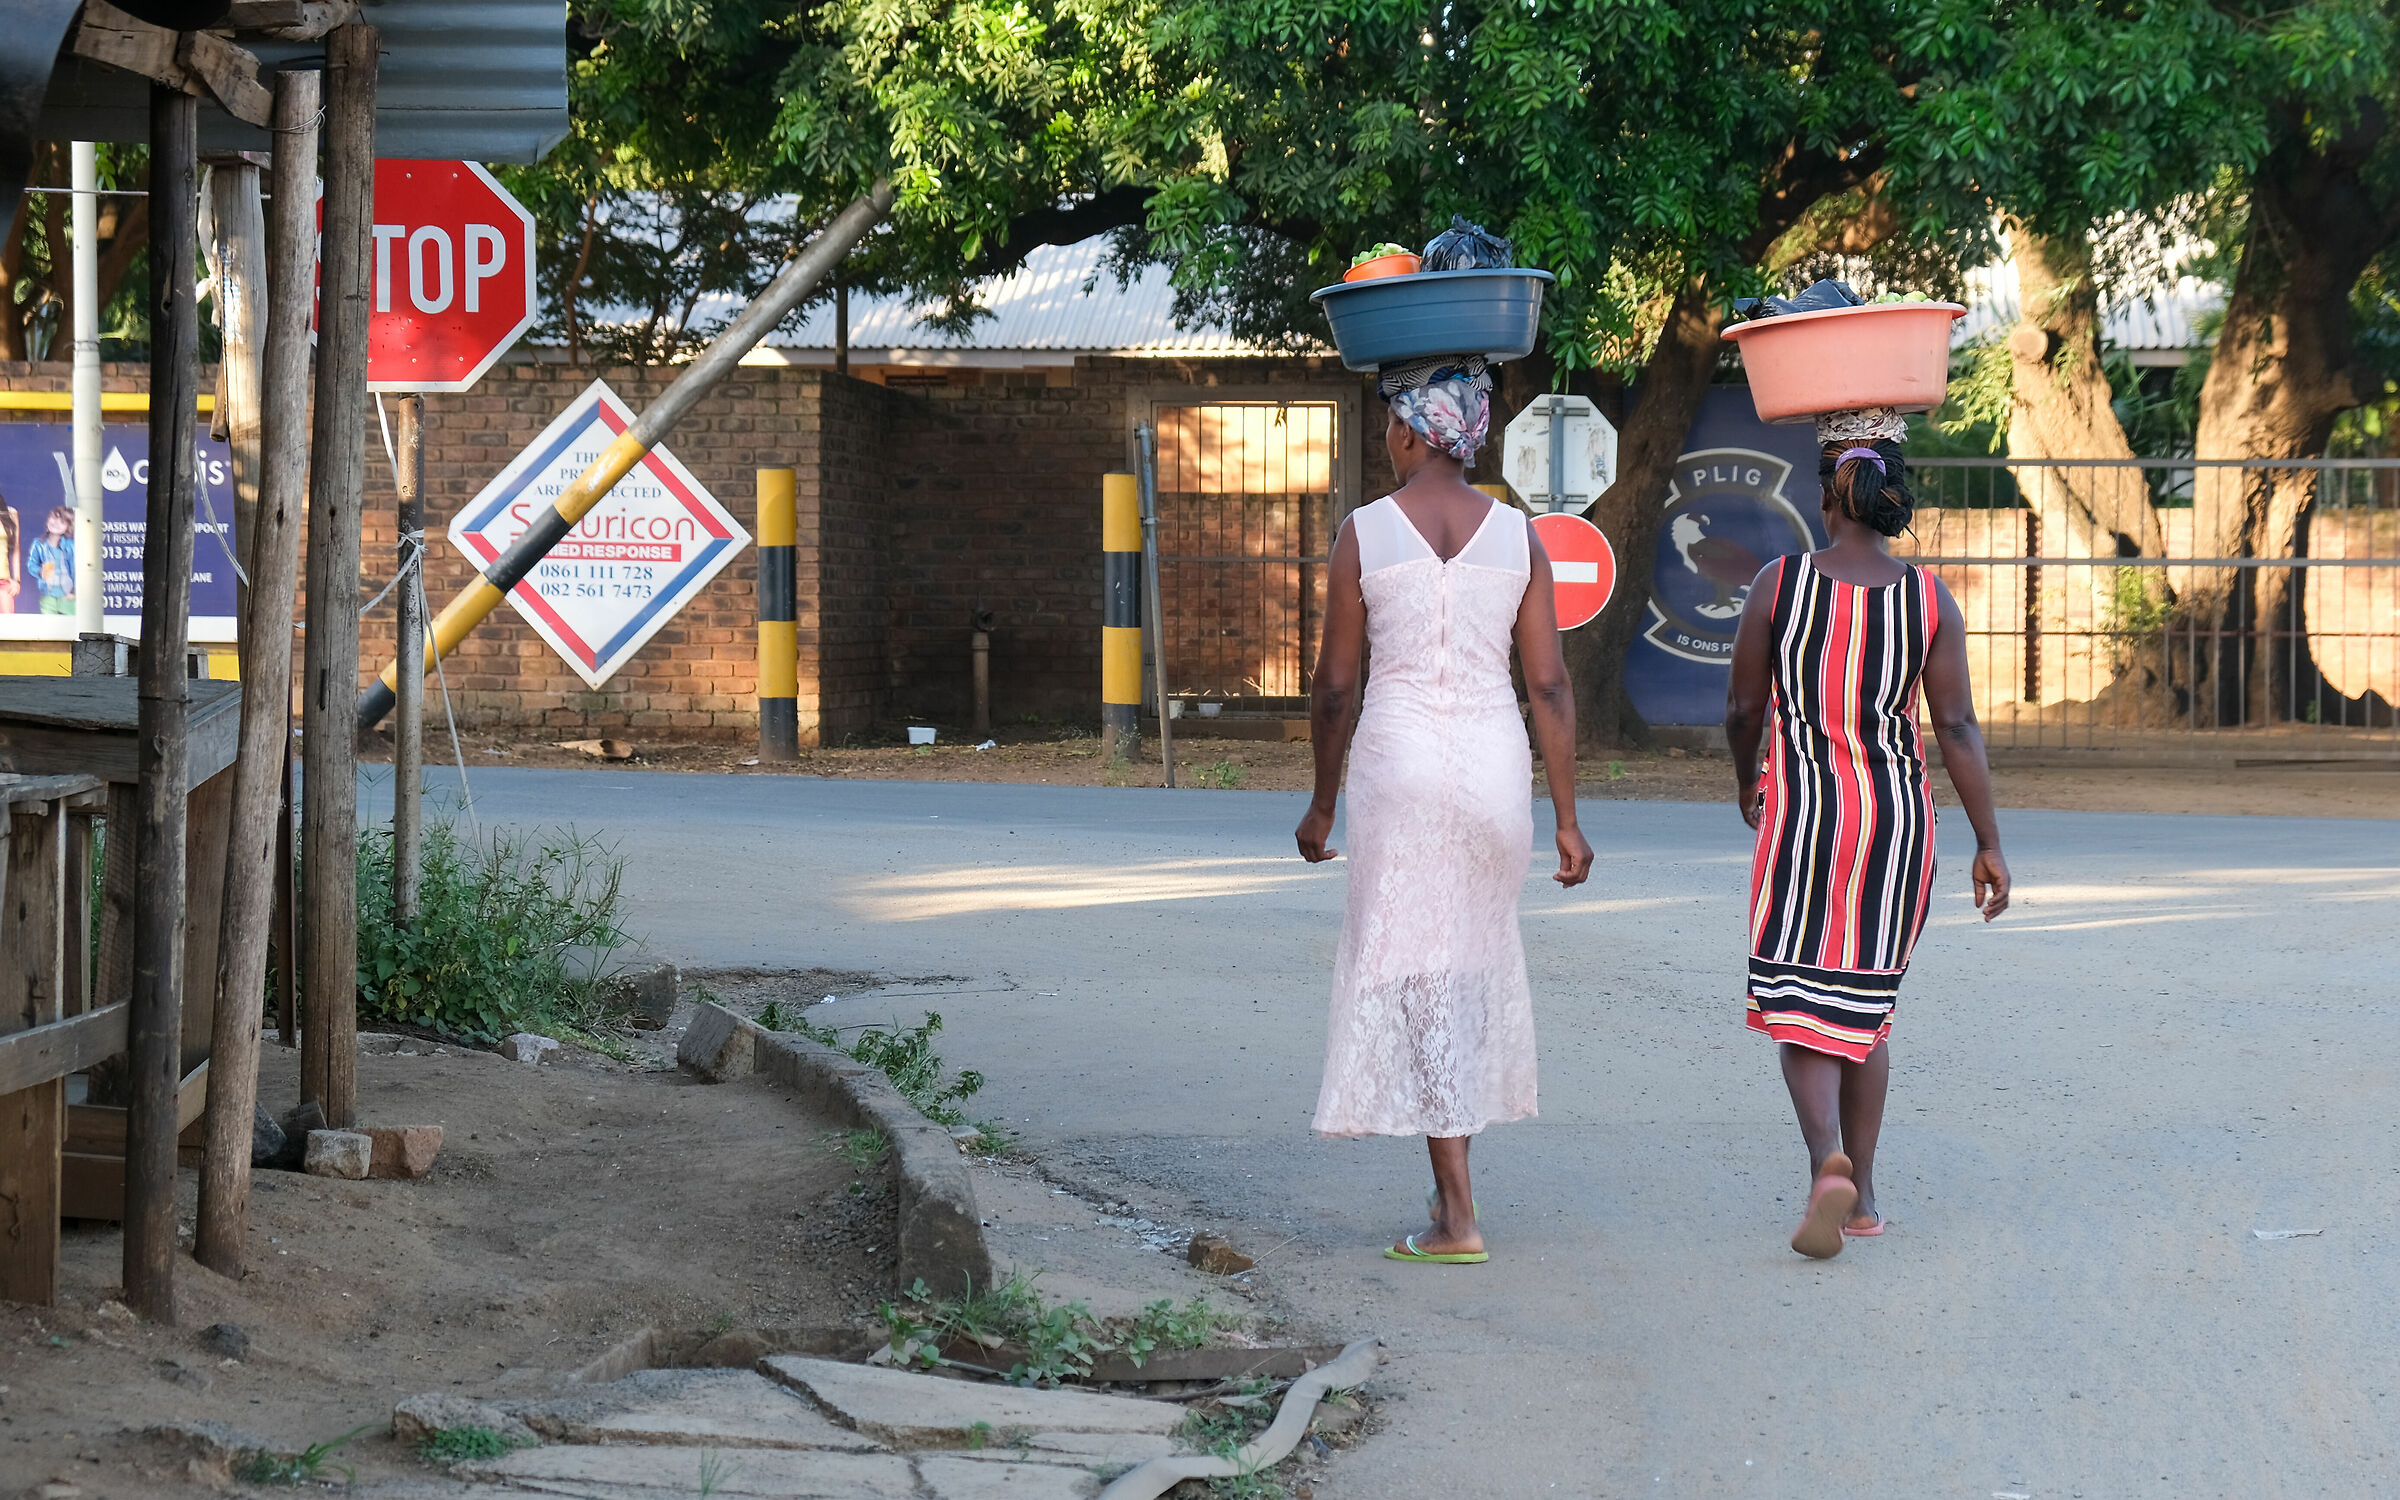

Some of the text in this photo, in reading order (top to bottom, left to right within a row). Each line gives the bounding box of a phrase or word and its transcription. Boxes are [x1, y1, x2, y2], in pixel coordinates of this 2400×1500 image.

[316, 224, 507, 314] TOP
[1693, 465, 1762, 486] PLIG
[510, 503, 695, 541] Suricon
[113, 533, 139, 544] RISSIK
[583, 544, 672, 559] RESPONSE
[540, 564, 653, 580] 0861 111 728
[541, 583, 651, 598] 082 561 7473
[1677, 634, 1690, 646] IS
[1692, 639, 1719, 652] ONS
